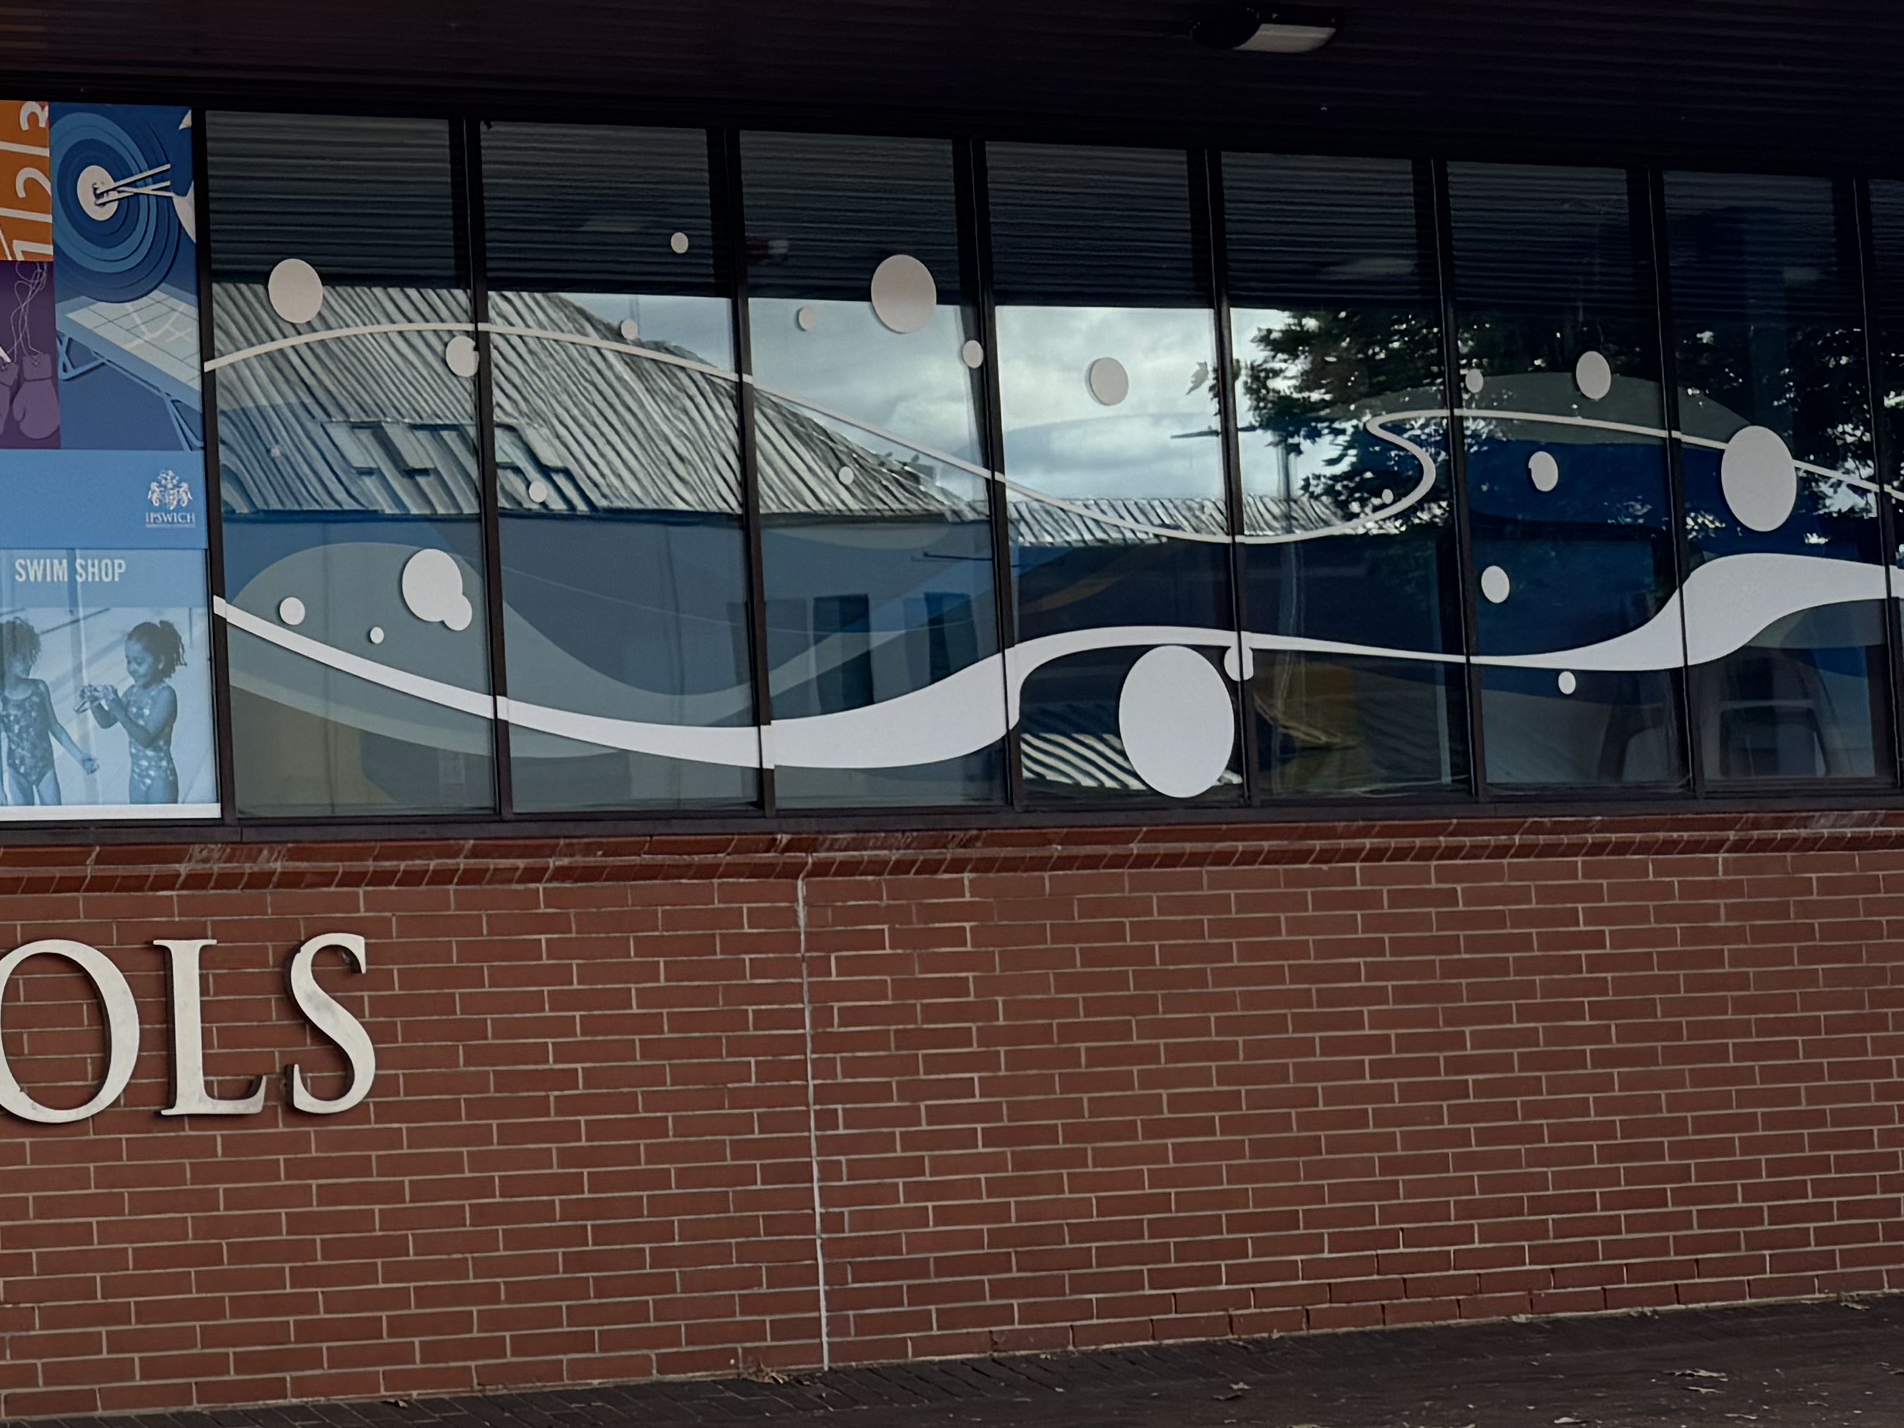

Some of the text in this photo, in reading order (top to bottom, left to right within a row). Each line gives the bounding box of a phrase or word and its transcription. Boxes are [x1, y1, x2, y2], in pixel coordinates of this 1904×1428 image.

[145, 512, 196, 523] IPSWICH
[15, 558, 127, 582] SWIM SHOP
